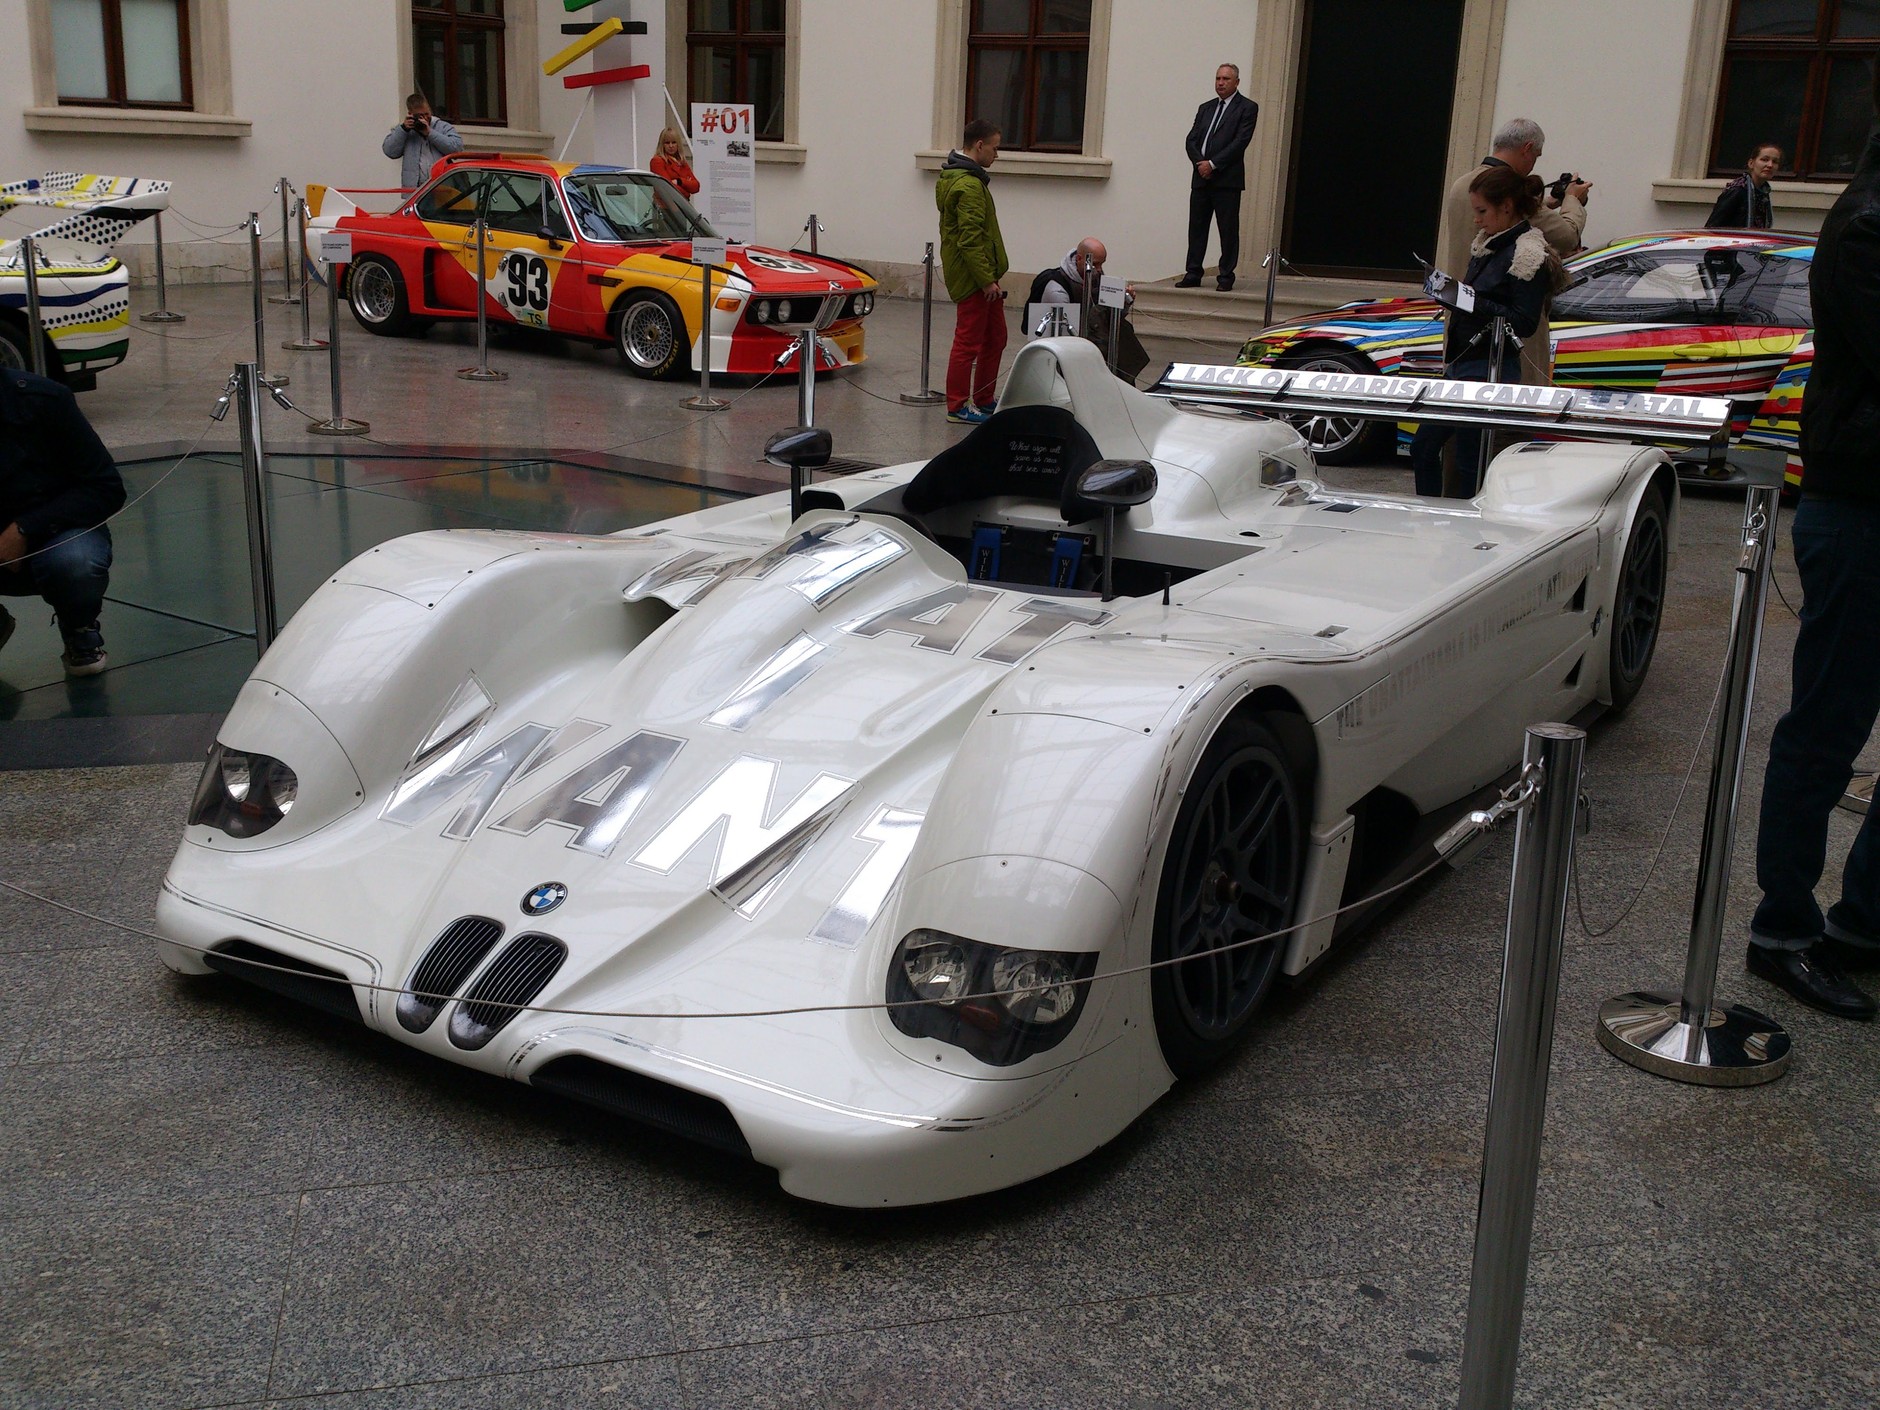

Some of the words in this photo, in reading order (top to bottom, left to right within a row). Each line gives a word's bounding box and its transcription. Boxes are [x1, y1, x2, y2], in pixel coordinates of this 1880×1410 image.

[701, 107, 750, 134] #01
[748, 256, 814, 272] 93
[508, 254, 549, 311] 93
[527, 312, 543, 325] TS
[1182, 366, 1252, 387] LACK
[1260, 371, 1300, 391] OF
[1308, 373, 1466, 400] CHARISMA
[1474, 384, 1544, 405] CAN
[1551, 389, 1592, 408] BE
[1607, 392, 1705, 418] FATAL
[1336, 695, 1363, 741] THE
